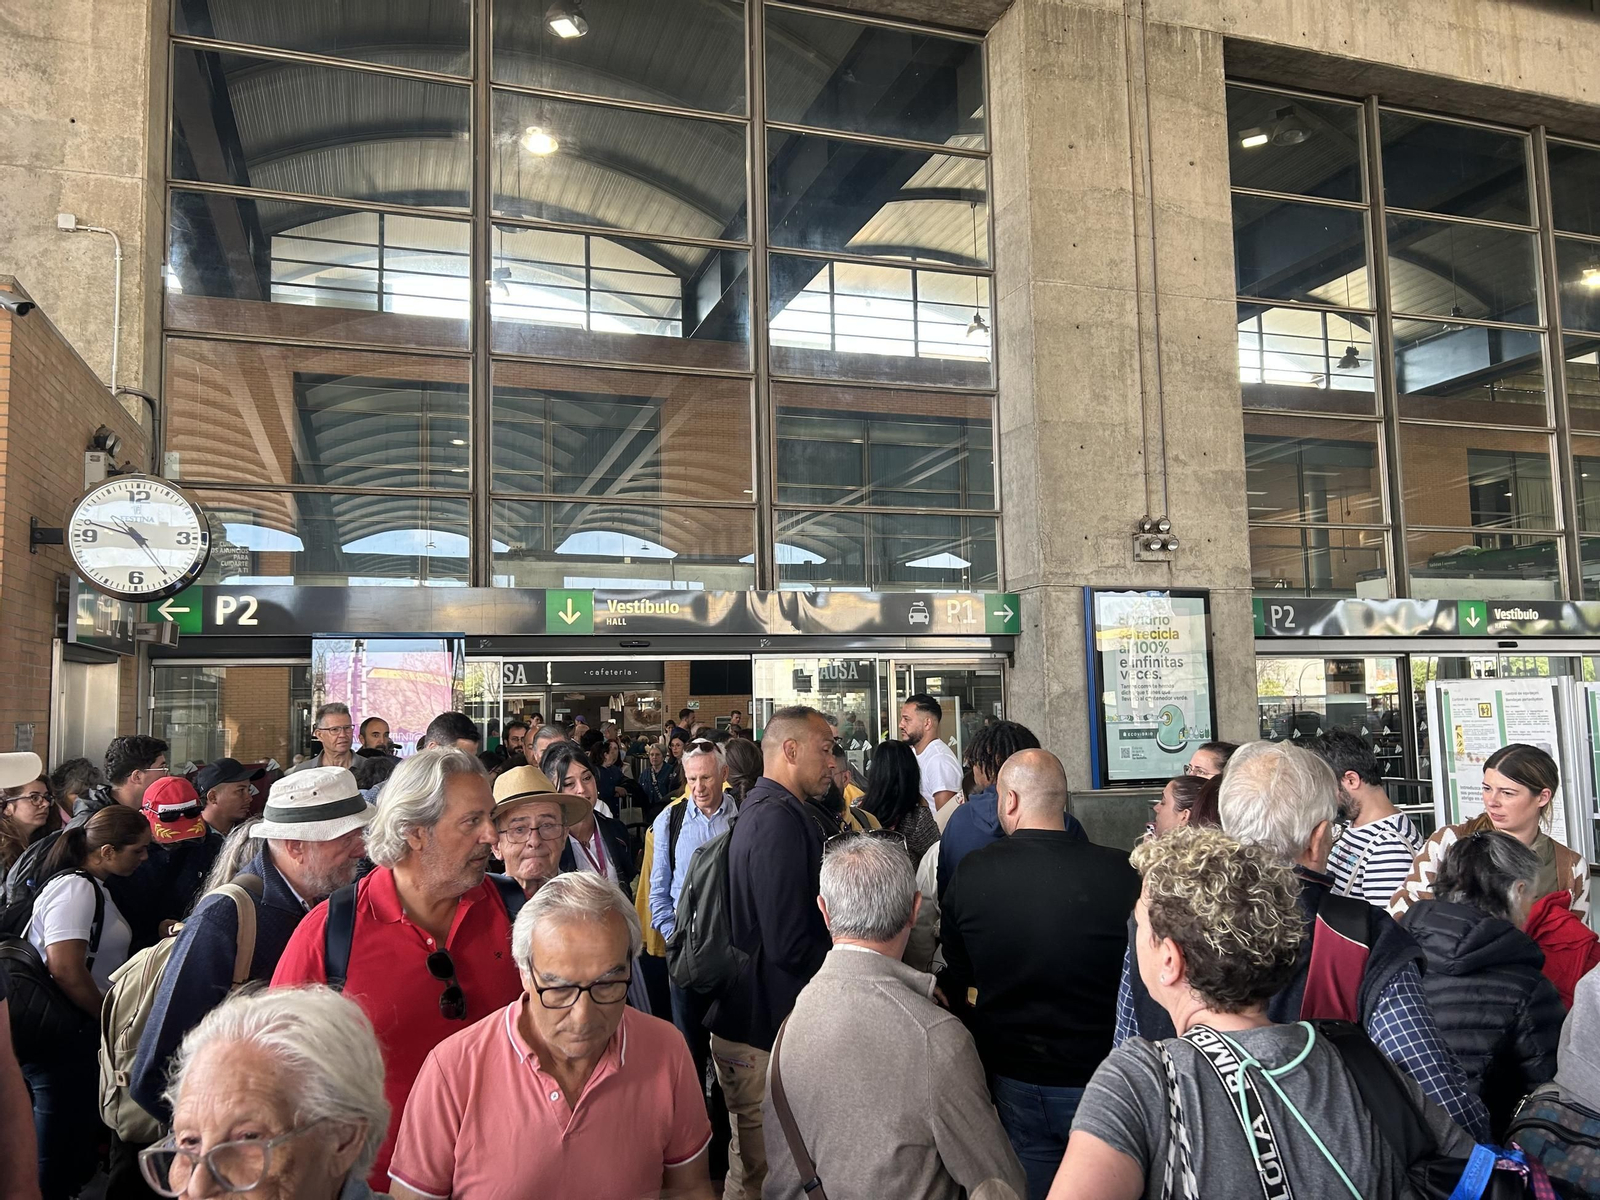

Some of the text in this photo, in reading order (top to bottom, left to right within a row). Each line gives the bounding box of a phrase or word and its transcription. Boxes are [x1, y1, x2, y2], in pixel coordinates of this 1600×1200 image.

[126, 490, 151, 504] 12
[81, 529, 98, 543] 9
[175, 531, 191, 545] 3
[128, 571, 144, 585] 6
[215, 595, 259, 626] P2
[606, 598, 680, 614] Vestíbulo
[946, 599, 977, 624] P1
[1270, 605, 1296, 628] P2
[1494, 607, 1539, 620] Vestíbulo
[606, 618, 627, 626] HALL
[1136, 627, 1180, 640] recicla
[1119, 641, 1170, 654] al 100%
[1119, 655, 1184, 669] e infinitas
[589, 667, 632, 676] cafeteria
[1120, 669, 1162, 681] veces.
